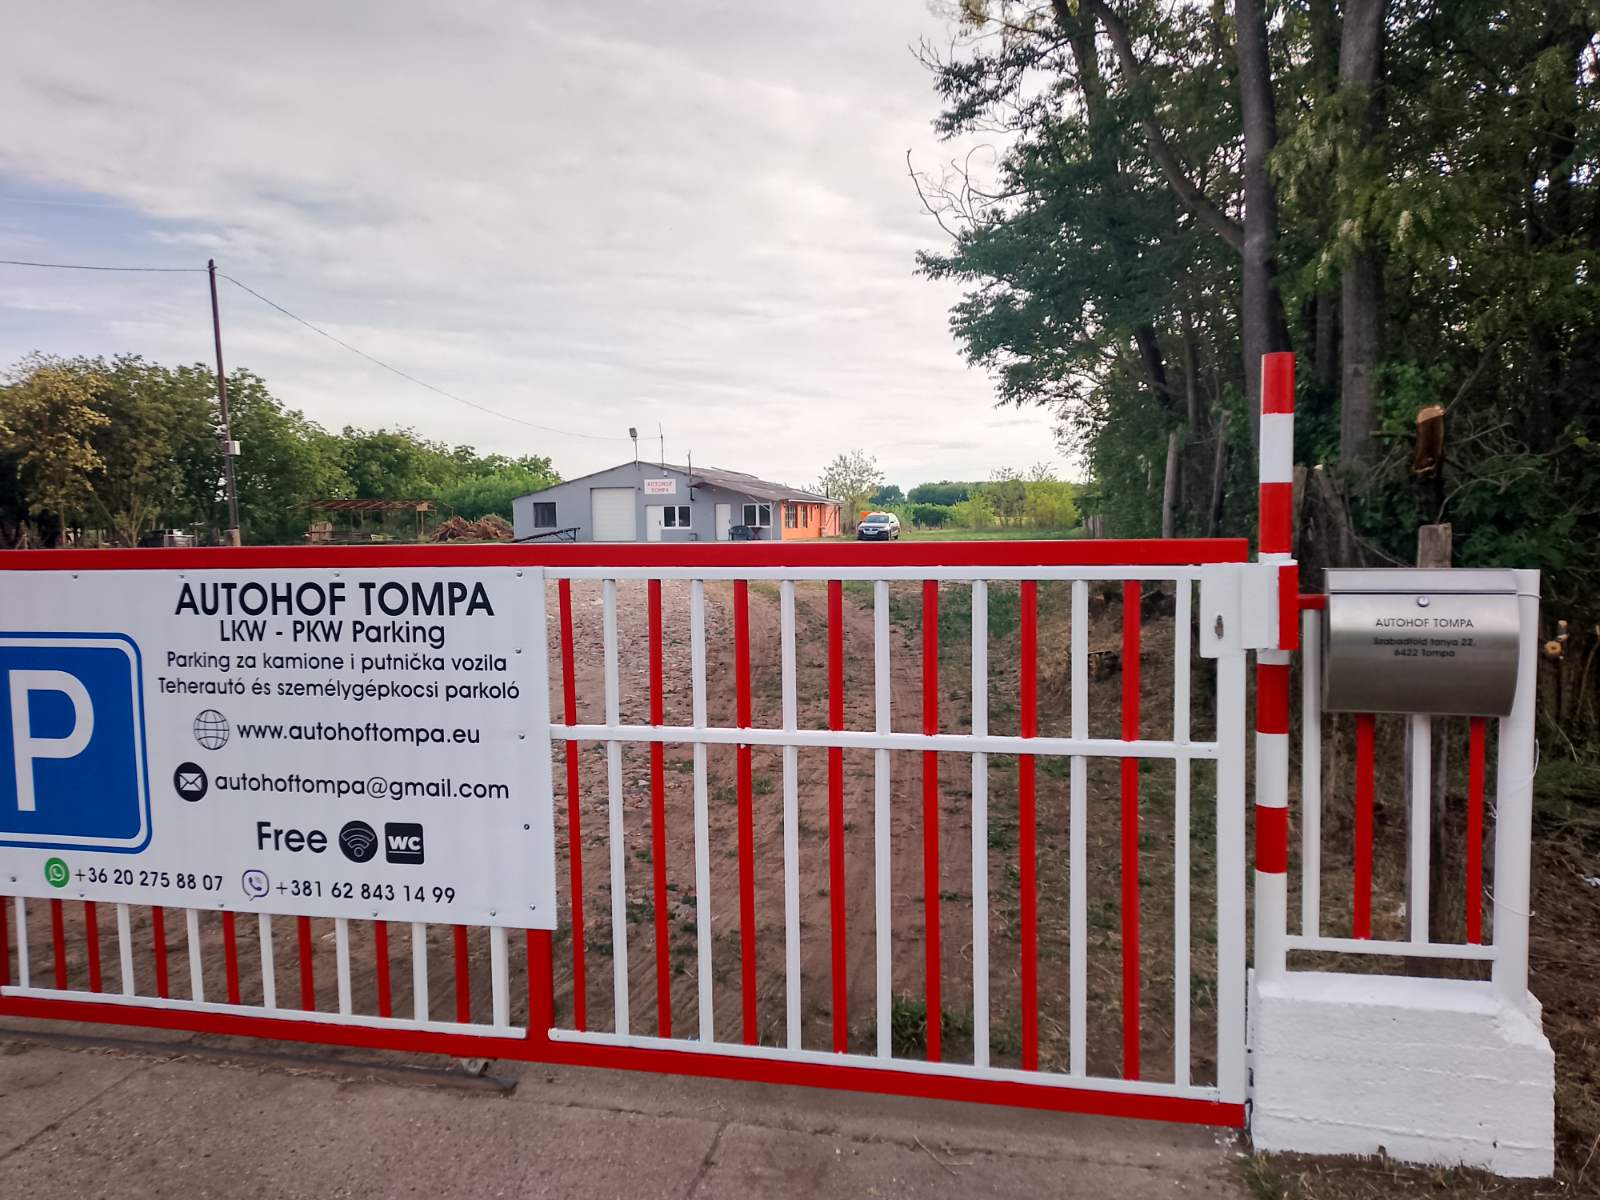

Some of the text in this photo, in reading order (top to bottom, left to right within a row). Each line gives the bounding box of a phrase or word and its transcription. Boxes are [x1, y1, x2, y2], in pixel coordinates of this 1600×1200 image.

[174, 581, 495, 617] AUTOHOF TOMPA
[220, 619, 267, 642] LKW
[292, 620, 343, 643] PKW
[352, 620, 445, 649] Parking
[1375, 618, 1474, 628] AUTOHOF TOMPA
[167, 651, 507, 674] Parking za kamione i putnička vozila
[1393, 648, 1455, 658] 6422 Tompa
[158, 676, 520, 702] Teherautó és személygépkocsi parkoló
[8, 668, 95, 812] P
[237, 721, 481, 747] www.autohoftompa.eu
[215, 772, 510, 801] autohoftompa@gmail.com
[256, 820, 422, 854] Free WC
[74, 867, 223, 891] +36 20 275 88 07
[276, 879, 456, 904] +381 62 843 14 99
